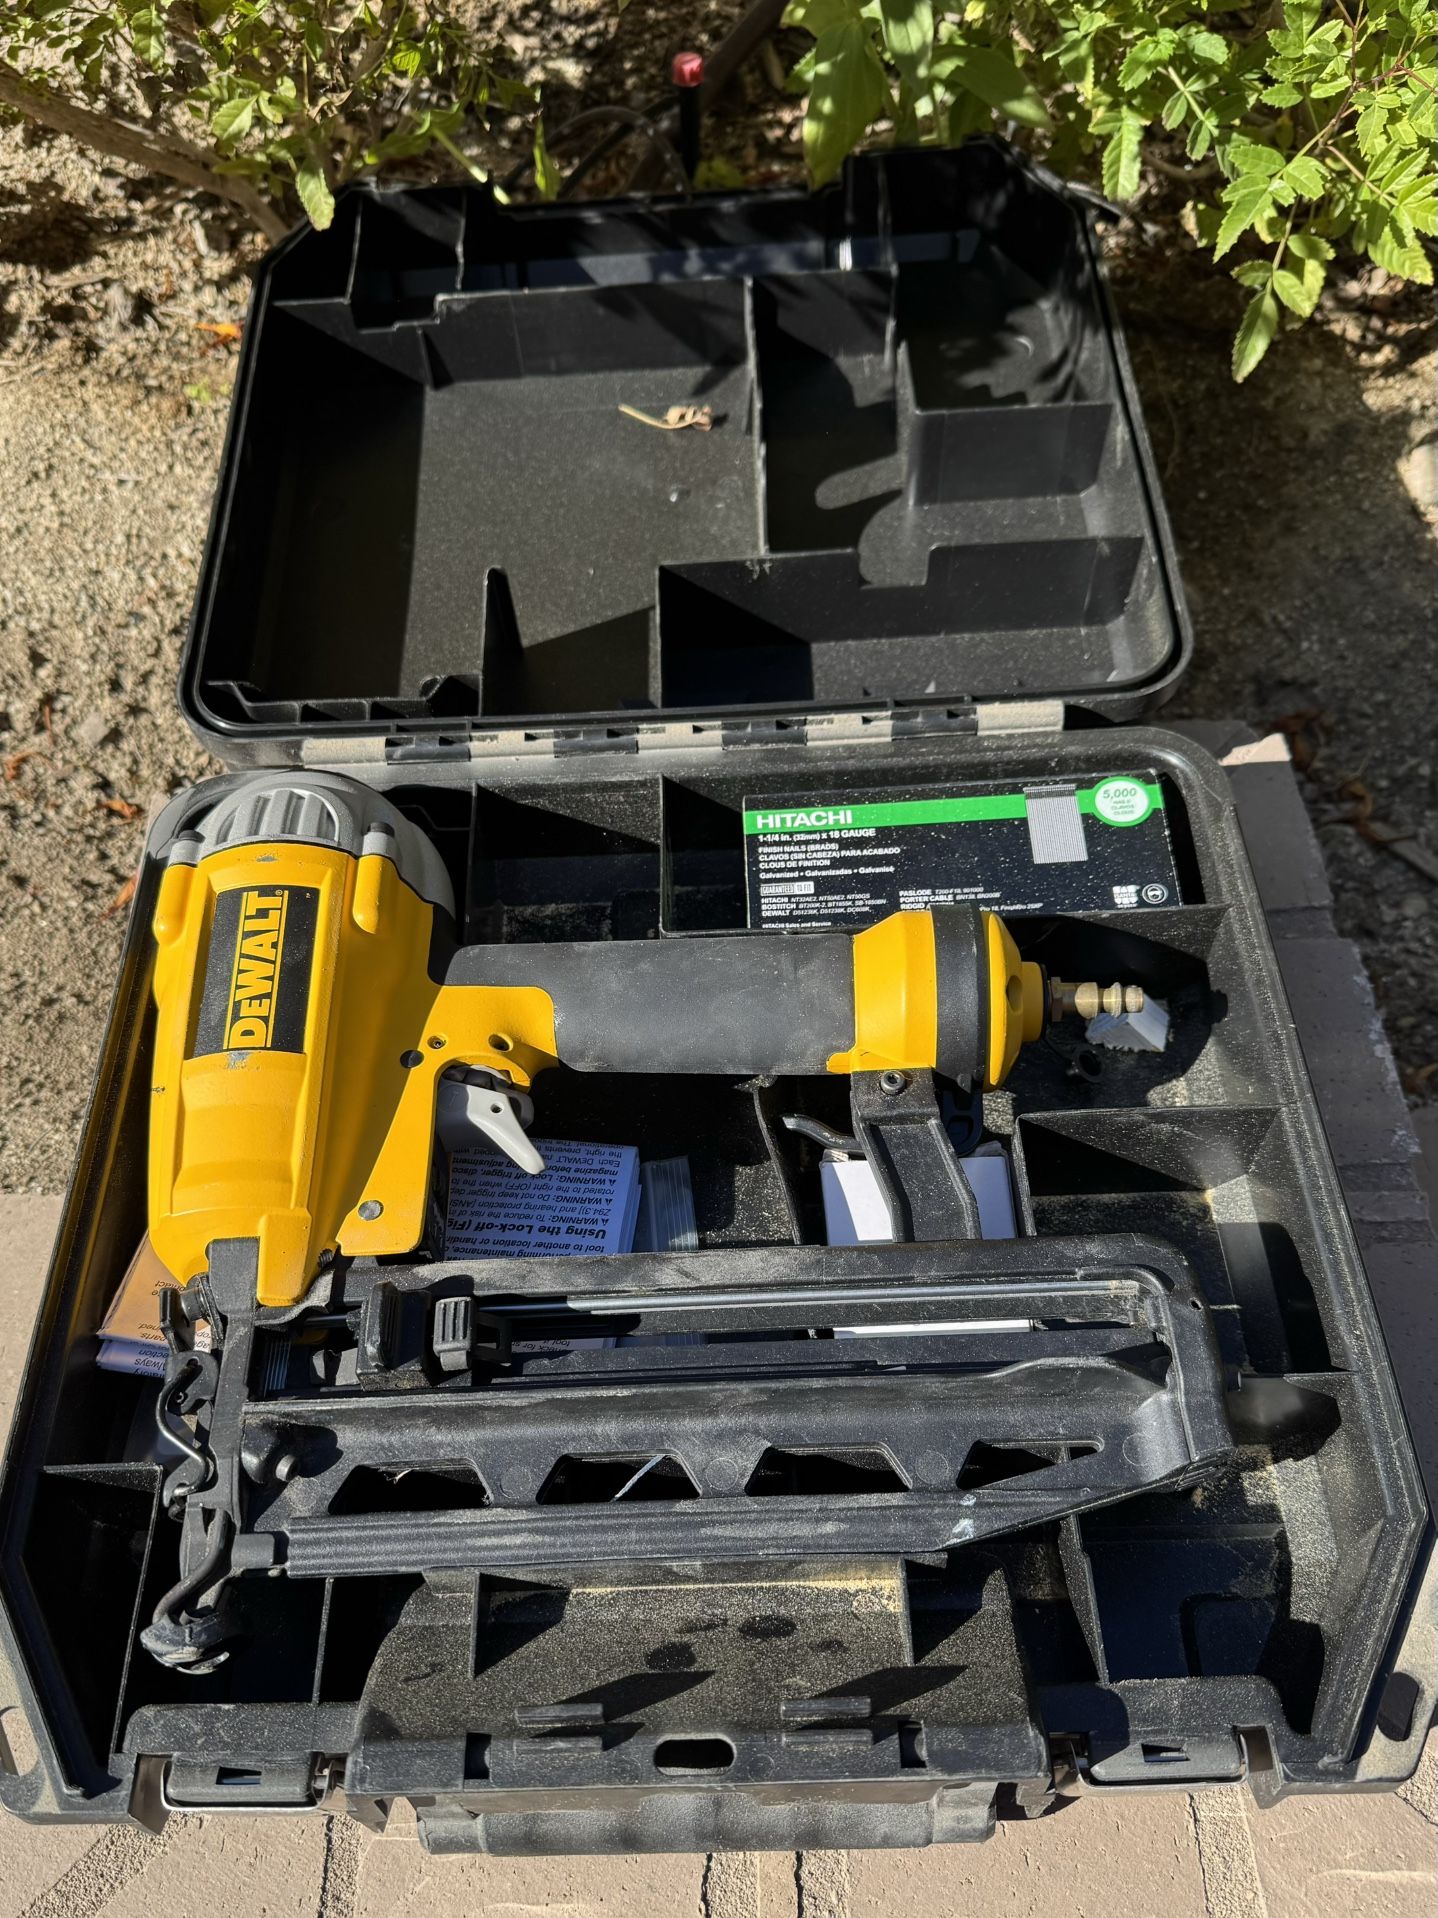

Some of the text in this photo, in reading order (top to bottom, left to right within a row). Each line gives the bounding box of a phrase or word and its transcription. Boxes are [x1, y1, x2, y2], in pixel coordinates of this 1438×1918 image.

[1103, 788, 1136, 799] 5,000
[757, 810, 852, 828] HITACHI
[758, 834, 779, 842] 1-1/4
[793, 833, 820, 841] (32mm)
[841, 828, 876, 837] GAUGE
[807, 843, 839, 852] (BRADS)
[791, 852, 806, 860] (SIN
[807, 851, 840, 859] CABEZA)
[862, 847, 900, 855] ACABADO
[759, 871, 798, 879] Galvanized
[805, 868, 852, 876] Galvanizadas
[899, 889, 932, 897] PASLODE
[229, 891, 282, 1048] DEWALT
[545, 1145, 581, 1154] prevents
[586, 1147, 605, 1157] right,
[598, 1159, 620, 1167] Each
[480, 1168, 513, 1178] trigger,
[546, 1165, 572, 1174] befor
[574, 1165, 618, 1176] magazine
[461, 1179, 476, 1187] the
[479, 1180, 502, 1188] when
[556, 1176, 606, 1185] WARNING:
[505, 1181, 531, 1190] (OFF)
[532, 1182, 553, 1192] right
[555, 1185, 569, 1193] the
[467, 1188, 496, 1197] trigger
[498, 1190, 519, 1199] keep
[583, 1187, 615, 1195] rotated
[552, 1194, 602, 1205] WARNING:
[477, 1200, 523, 1210] protection
[524, 1202, 556, 1212] hearing
[458, 1209, 467, 1217] of
[504, 1212, 534, 1220] reduce
[548, 1214, 599, 1225] WARNING:
[476, 1221, 534, 1234] Lock-off
[538, 1225, 561, 1236] the
[565, 1226, 607, 1240] Using
[492, 1239, 531, 1248] location
[533, 1241, 571, 1250] another
[452, 1246, 515, 1256] maintenance,
[586, 1245, 604, 1253] tool
